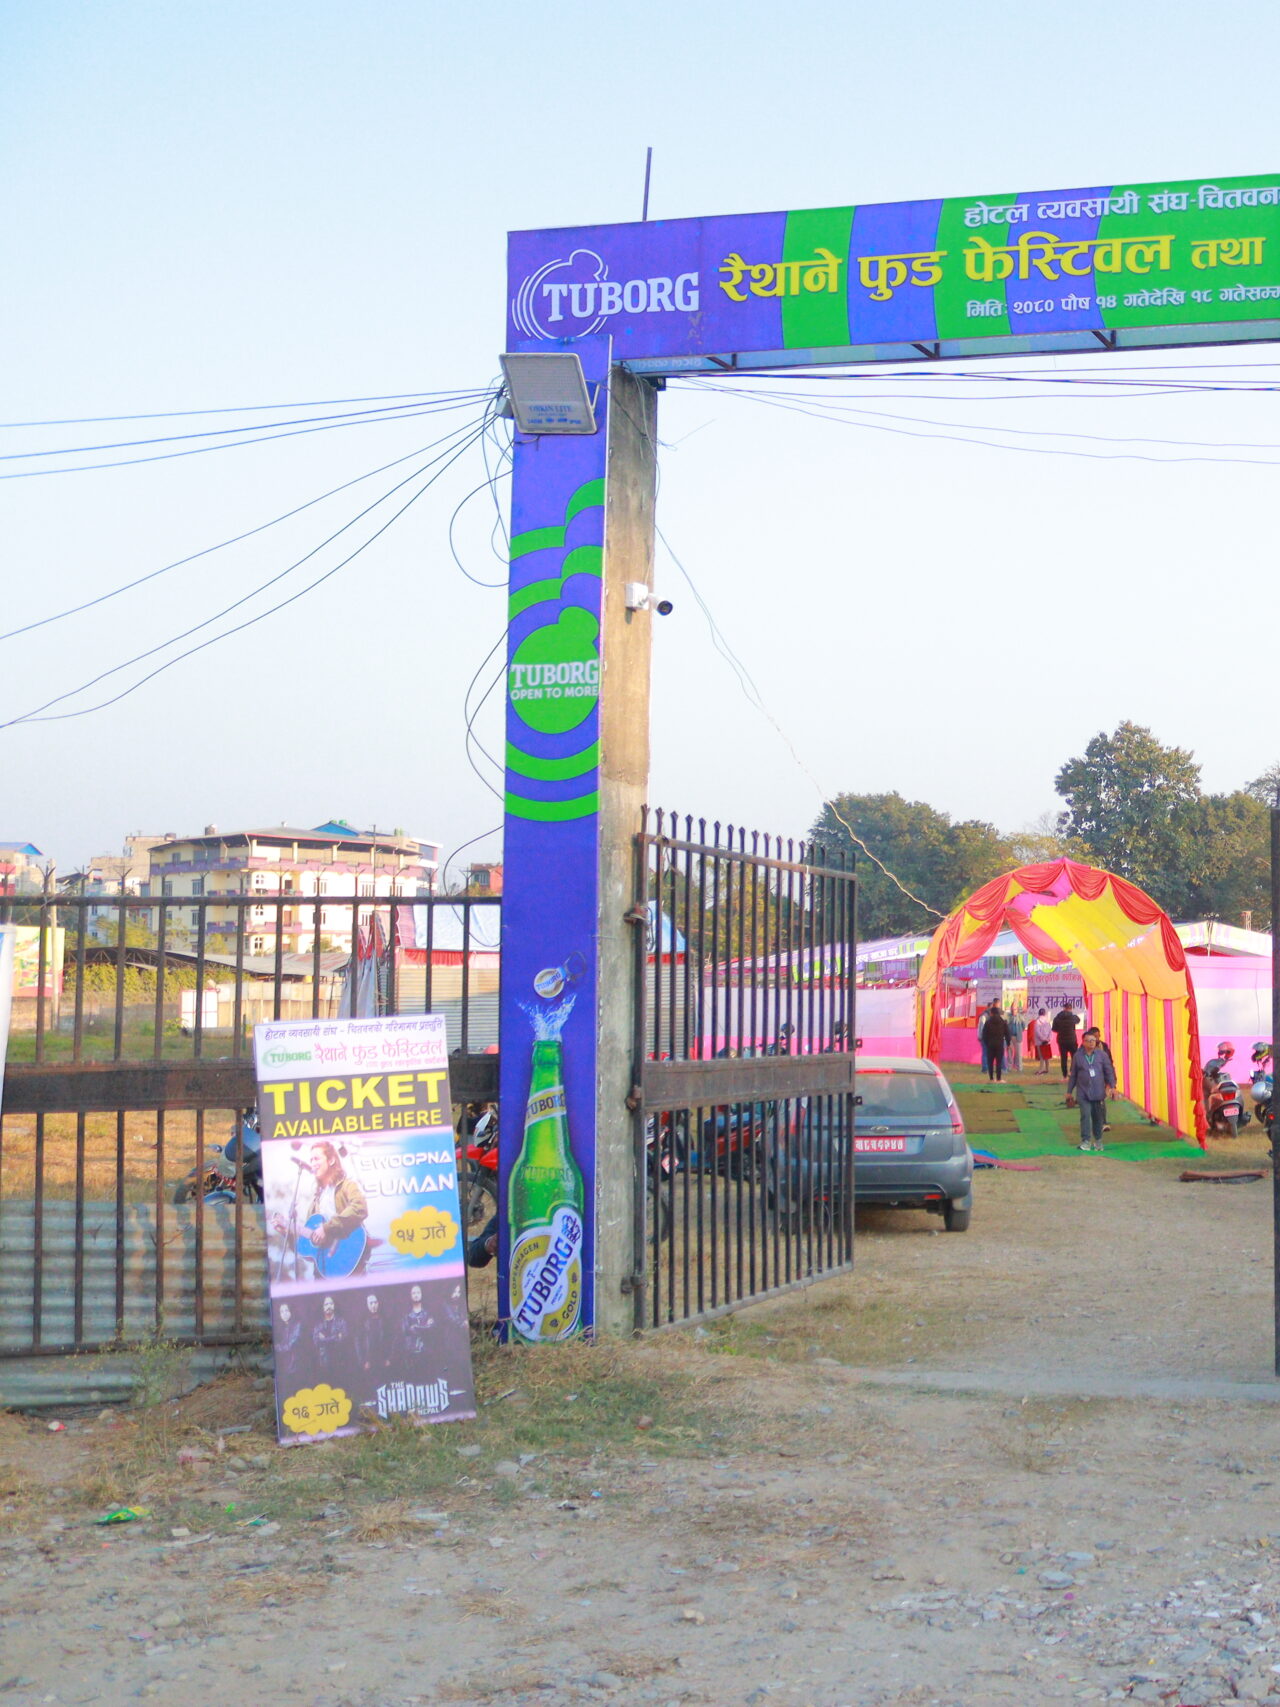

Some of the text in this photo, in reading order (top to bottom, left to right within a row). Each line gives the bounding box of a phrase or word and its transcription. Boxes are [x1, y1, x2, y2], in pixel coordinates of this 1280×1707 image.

[964, 202, 1028, 228] होटल
[1036, 191, 1141, 220] व्यवसायी
[719, 248, 843, 302] रैथाने
[858, 249, 947, 301] फुड
[963, 230, 1175, 282] फेस्टिवल
[1191, 236, 1266, 269] तथा
[542, 271, 700, 323] TUBORG
[1012, 297, 1055, 314] २०८०
[1060, 291, 1091, 312] पौष
[1095, 294, 1118, 309] १४
[1123, 284, 1186, 308] गतेदेखि
[1191, 288, 1213, 304] १८
[510, 659, 600, 688] TUBORG
[510, 685, 599, 700] OPEN TO MORE
[270, 1051, 312, 1063] TUBORG
[263, 1071, 447, 1115] TICKET
[273, 1109, 443, 1138] AVAILABLE HERE
[363, 1174, 454, 1198] SUMAN
[420, 1223, 448, 1240] गते
[512, 1242, 539, 1297] COPENHAGEN
[517, 1236, 573, 1330] TUBORG
[562, 1290, 578, 1320] GOLD
[315, 1399, 340, 1417] गते
